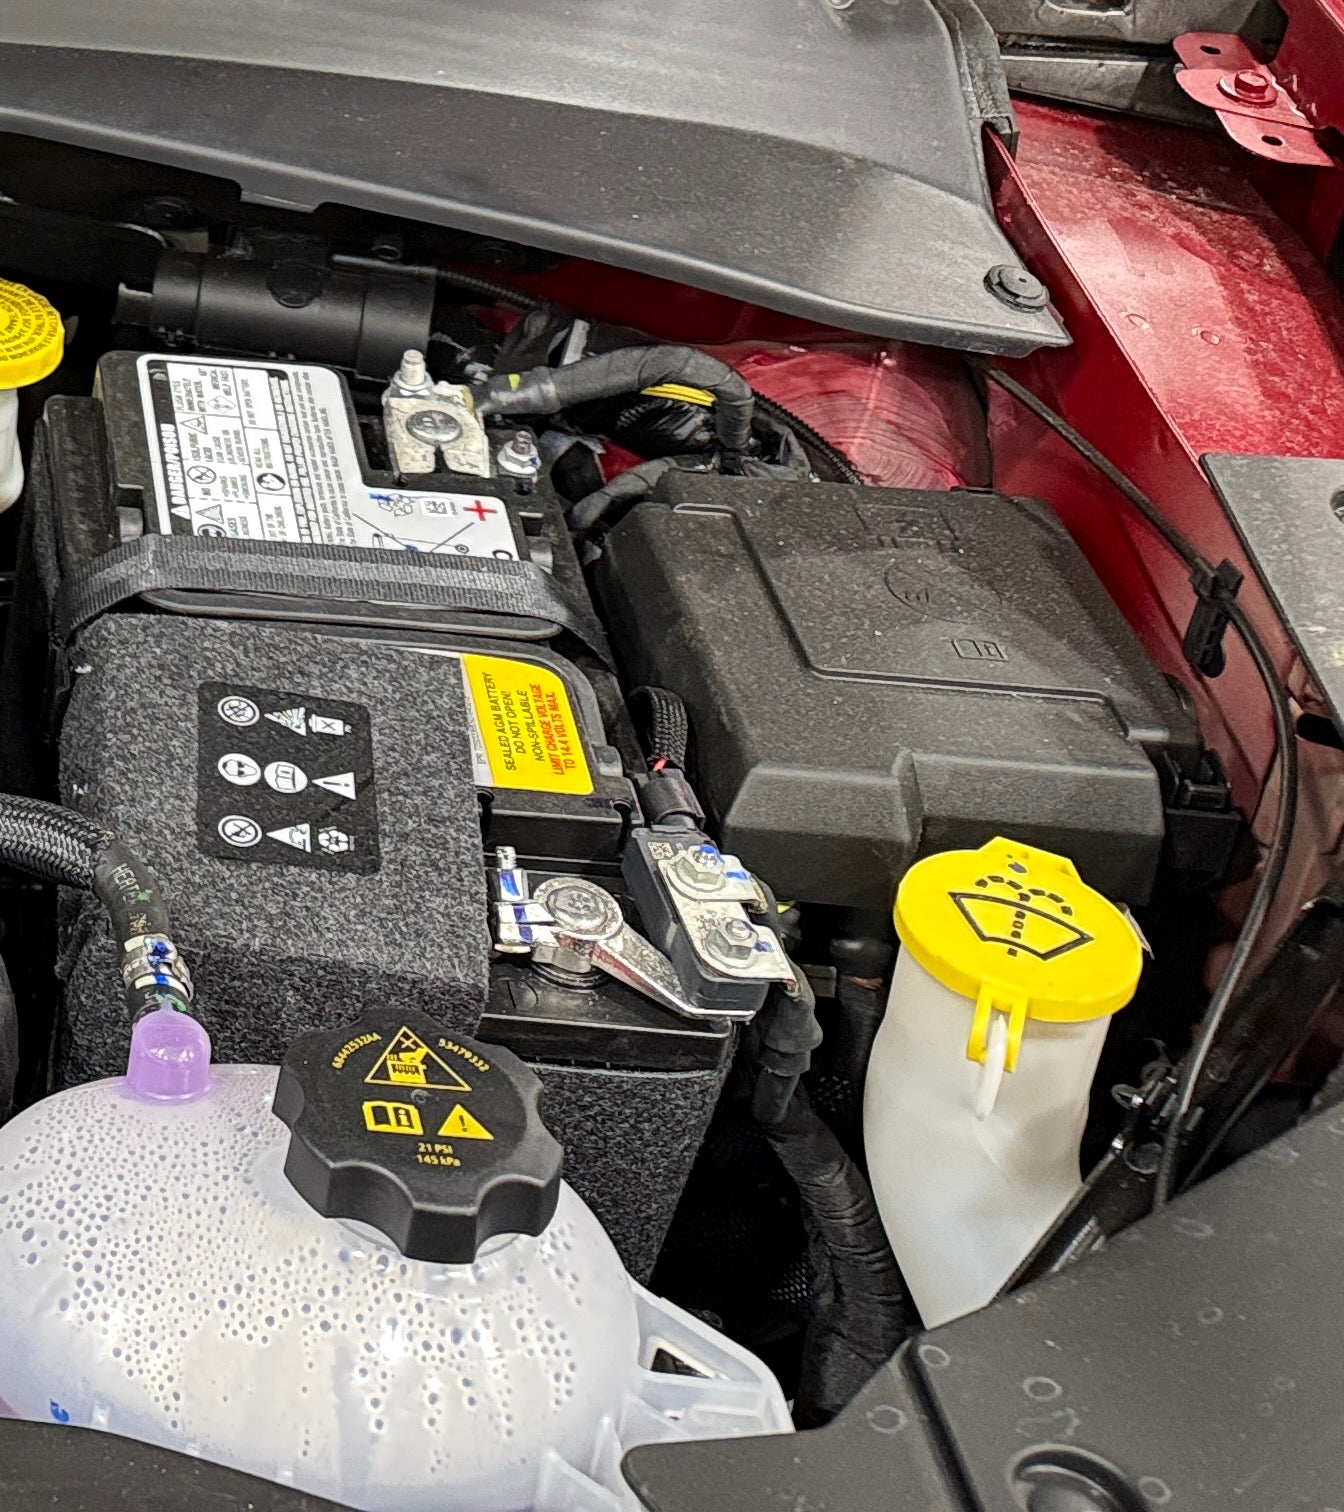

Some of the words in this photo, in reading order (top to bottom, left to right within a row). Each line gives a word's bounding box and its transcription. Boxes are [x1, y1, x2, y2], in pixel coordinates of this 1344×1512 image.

[160, 423, 187, 506] DANGER/POISON
[482, 671, 502, 712] BATTERY
[529, 682, 550, 719] VOLTAGE
[500, 690, 517, 719] OPEN!
[493, 713, 507, 735] AGM
[508, 720, 521, 739] NOT
[517, 689, 546, 762] NON-SPILLABLE
[540, 719, 558, 752] CHARGE
[551, 713, 568, 739] VOLTS
[498, 735, 518, 772] SEALED
[513, 740, 527, 755] DO
[558, 738, 573, 757] 14.4
[548, 752, 565, 776] LIMIT
[563, 757, 577, 770] TO
[416, 1154, 439, 1166] 145
[440, 1155, 462, 1168] kPa
[418, 1142, 433, 1153] 21
[435, 1143, 454, 1155] PSI
